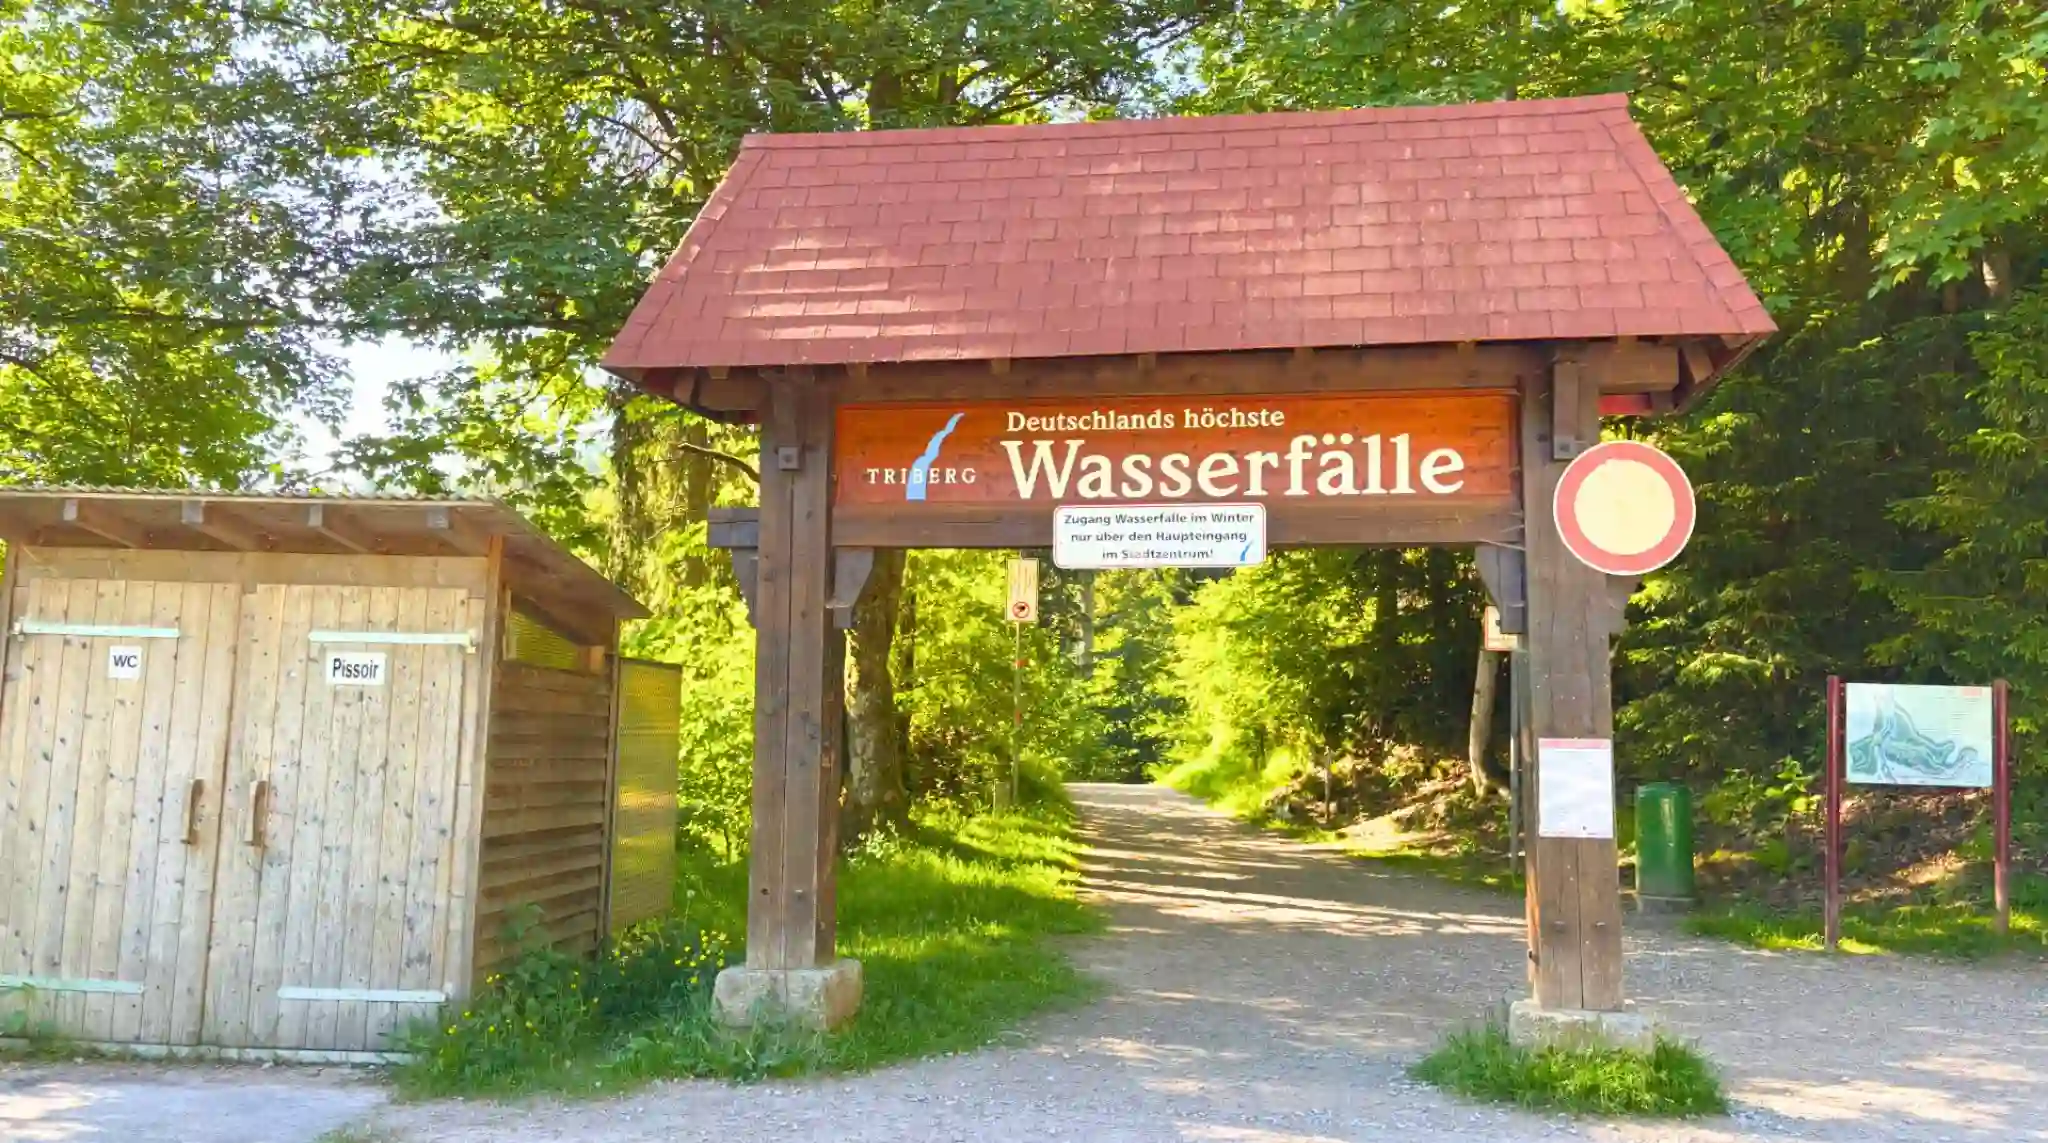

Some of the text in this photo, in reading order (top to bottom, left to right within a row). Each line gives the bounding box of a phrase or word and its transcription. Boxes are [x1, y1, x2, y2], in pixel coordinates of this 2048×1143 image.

[1006, 408, 1285, 432] Deutschlands höchste
[1000, 432, 1465, 499] Wasserfälle
[867, 467, 977, 485] TRIBERG
[1064, 514, 1111, 526] Zugang
[1191, 512, 1207, 523] im
[1211, 512, 1254, 523] Winter
[1071, 532, 1092, 542] nur
[1128, 531, 1152, 541] den
[1156, 531, 1247, 543] Haupteingang
[1102, 549, 1118, 560] im
[113, 654, 138, 669] WC
[332, 657, 380, 679] Pissoir
